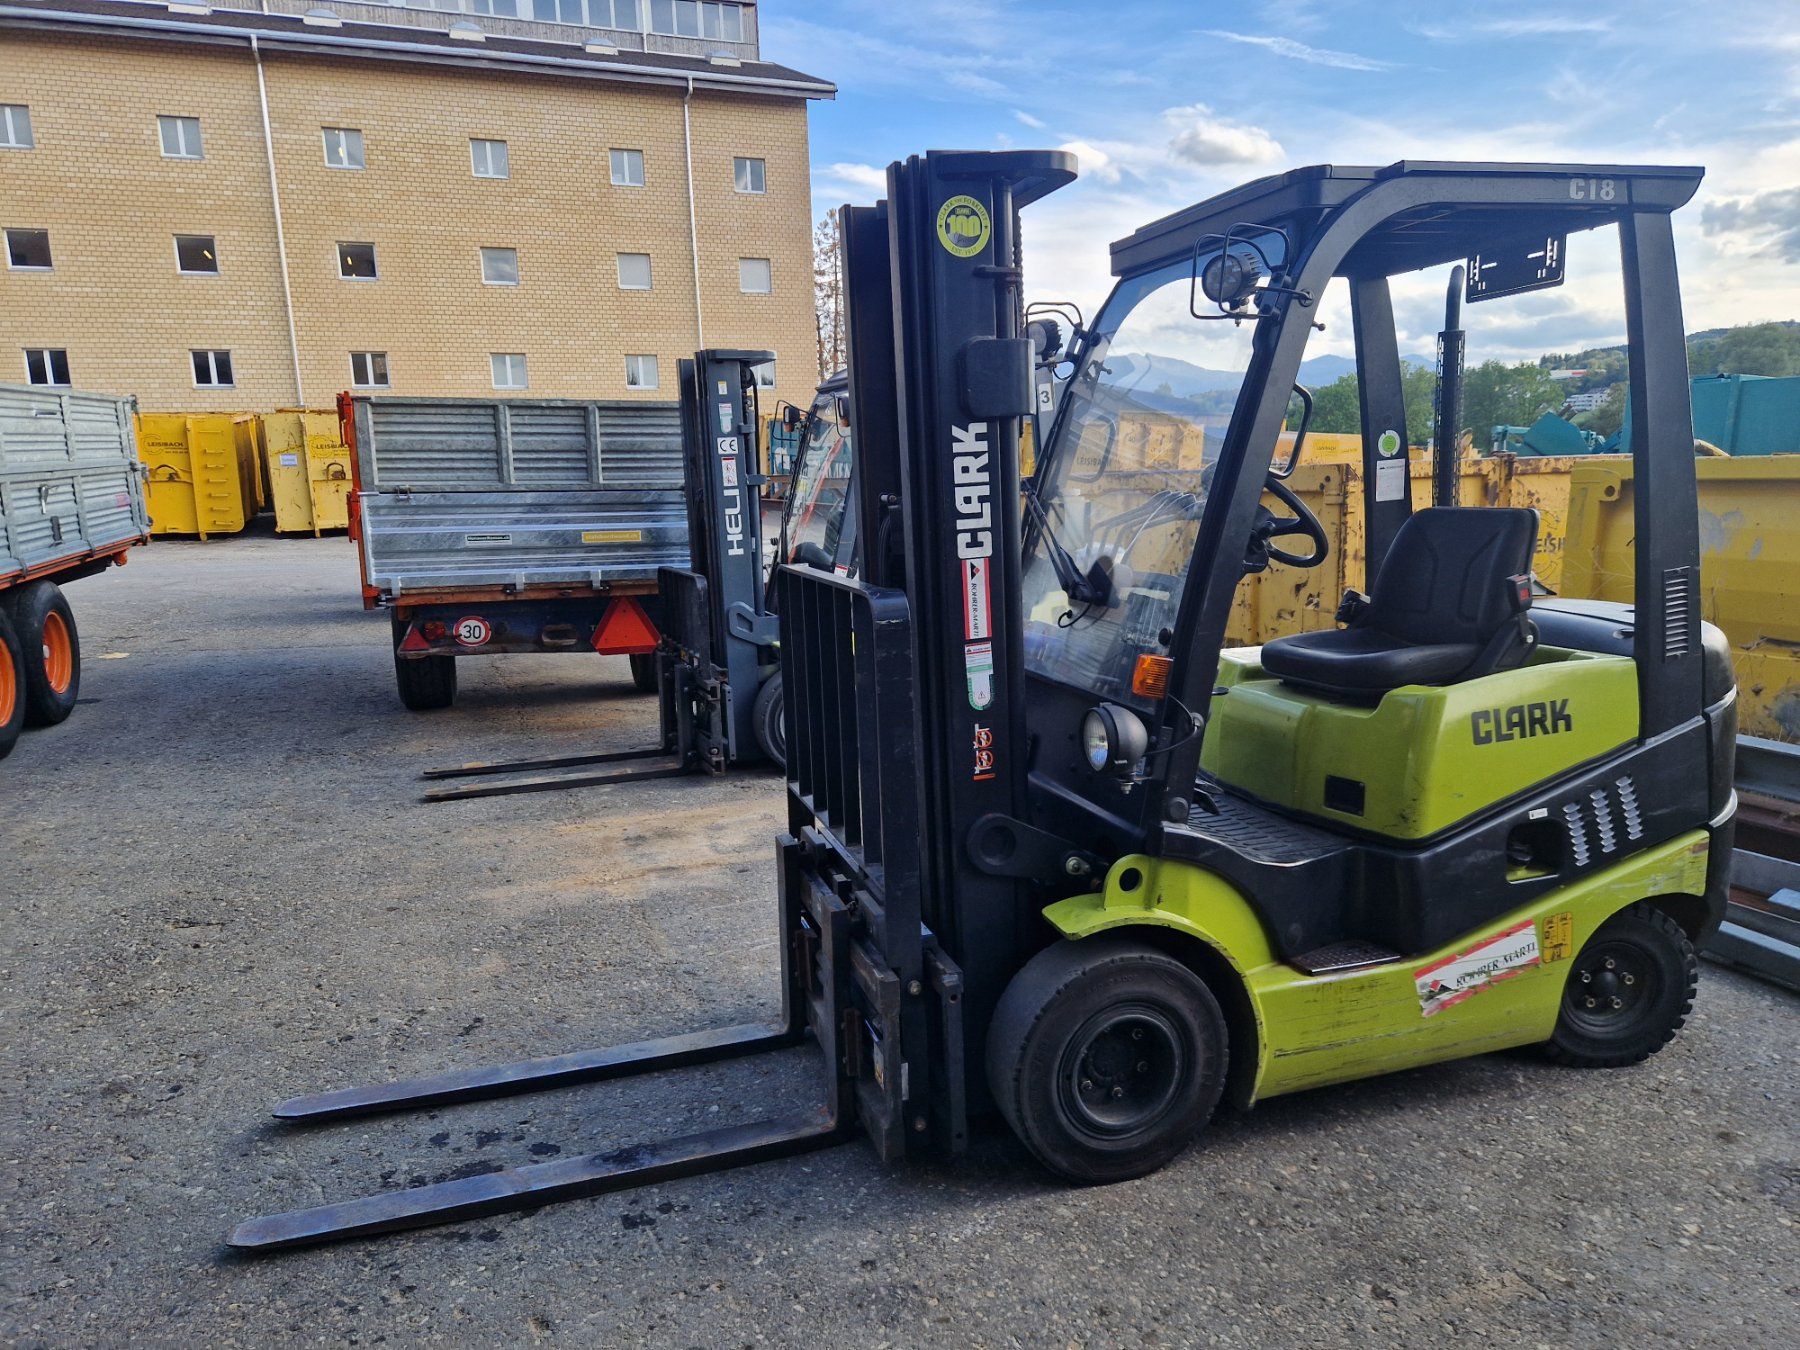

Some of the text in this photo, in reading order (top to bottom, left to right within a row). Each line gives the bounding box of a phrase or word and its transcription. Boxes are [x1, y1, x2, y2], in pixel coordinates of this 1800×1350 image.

[1569, 178, 1615, 200] C18
[947, 215, 981, 237] 100
[951, 422, 992, 559] CLARK
[723, 488, 745, 556] HELI
[463, 625, 481, 639] 30
[1471, 699, 1572, 745] CLARK
